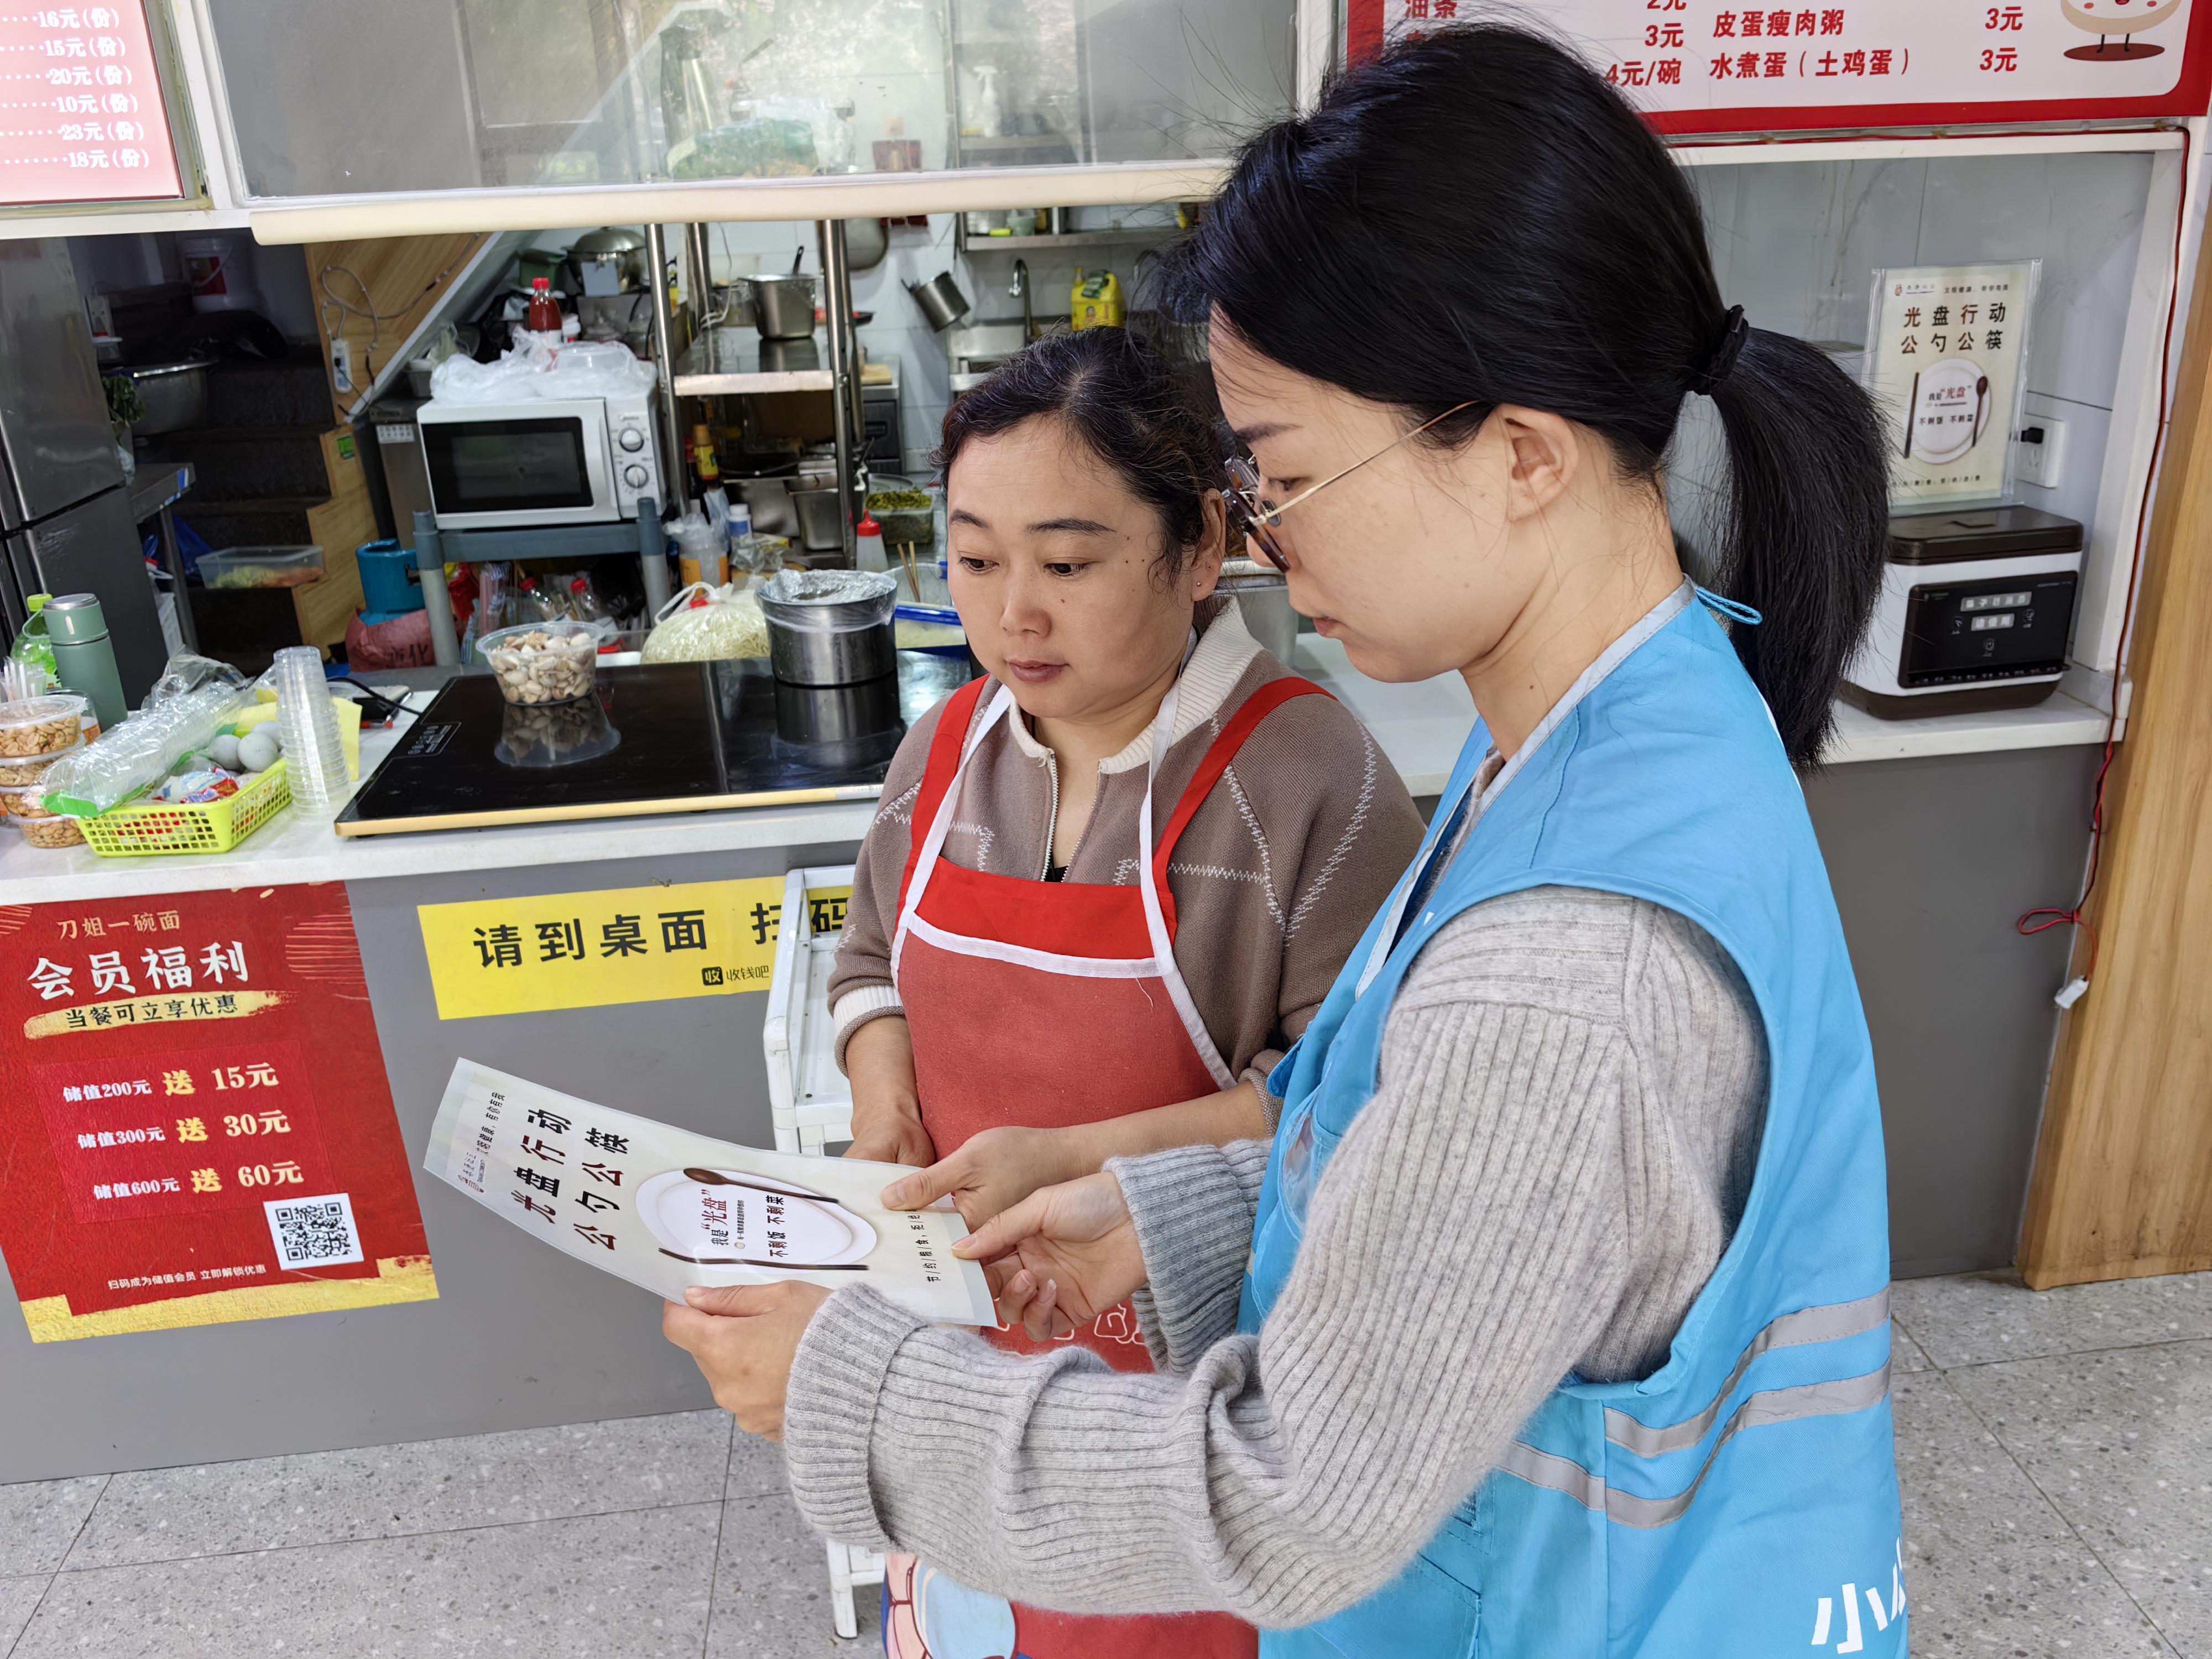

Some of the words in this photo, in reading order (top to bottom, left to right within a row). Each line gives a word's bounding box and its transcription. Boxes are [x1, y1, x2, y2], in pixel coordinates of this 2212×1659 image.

[37, 8, 119, 28] 16元（份）
[1713, 9, 1845, 38] 皮蛋瘦肉粥
[1985, 7, 2023, 31] 3元
[44, 36, 126, 57] 15元（份）
[1645, 23, 1684, 48] 3元
[49, 65, 132, 85] 20元（份）
[1604, 58, 1682, 86] 4元/碗
[1709, 48, 1909, 80] 水煮蛋（土鸡蛋）
[1979, 48, 2018, 73] 3元
[56, 93, 138, 113] 10元（份）
[67, 149, 149, 168] 18元（份）
[1904, 302, 2006, 327] 光盘行动
[1901, 330, 2003, 354] 公勺公筷
[57, 910, 180, 940] 刀姐一碗面
[473, 909, 707, 969] 请到桌面
[27, 941, 249, 1000] 会员福利
[726, 966, 769, 982] 收钱吧
[66, 994, 238, 1029] 当餐可立享优惠
[62, 1078, 152, 1102] 储值200元
[162, 1070, 196, 1097] 送
[211, 1062, 279, 1091] 15元
[77, 1126, 165, 1150] 储值300元
[176, 1117, 208, 1144] 送
[223, 1109, 291, 1137] 30元
[93, 1176, 181, 1200] 储值600元
[191, 1168, 223, 1194] 送
[238, 1160, 305, 1188] 60元
[511, 1109, 572, 1224] 光盘行动
[573, 1127, 630, 1250] 公勺公筷
[701, 1189, 729, 1245] 我是“光盘”
[766, 1195, 785, 1224] 不剩菜
[767, 1231, 789, 1258] 不剩饭
[108, 1271, 196, 1290] 扫码成为储值会员
[200, 1264, 266, 1280] 立即解锁优惠
